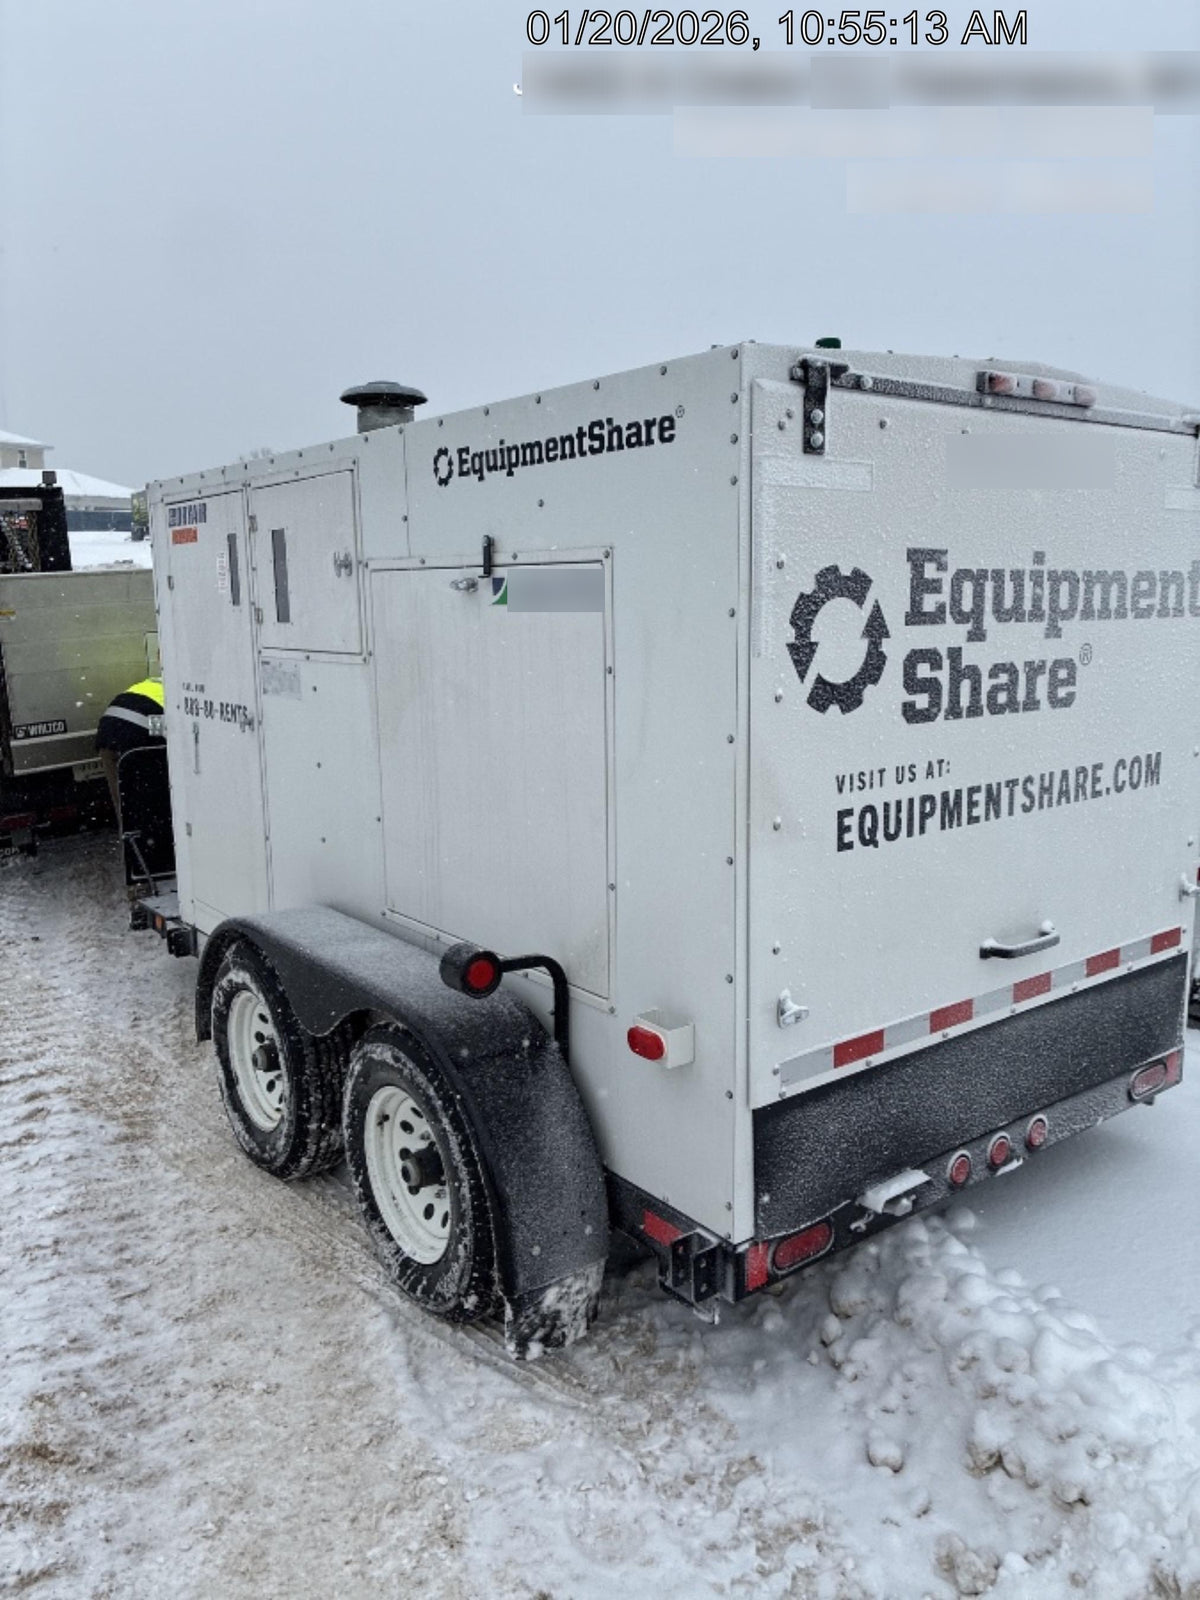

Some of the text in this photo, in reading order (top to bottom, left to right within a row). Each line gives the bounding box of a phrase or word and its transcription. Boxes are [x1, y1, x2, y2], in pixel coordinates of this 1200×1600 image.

[835, 758, 951, 794] VISIT US AT:
[836, 752, 1162, 852] EQUIPMENTSHARE.COM
